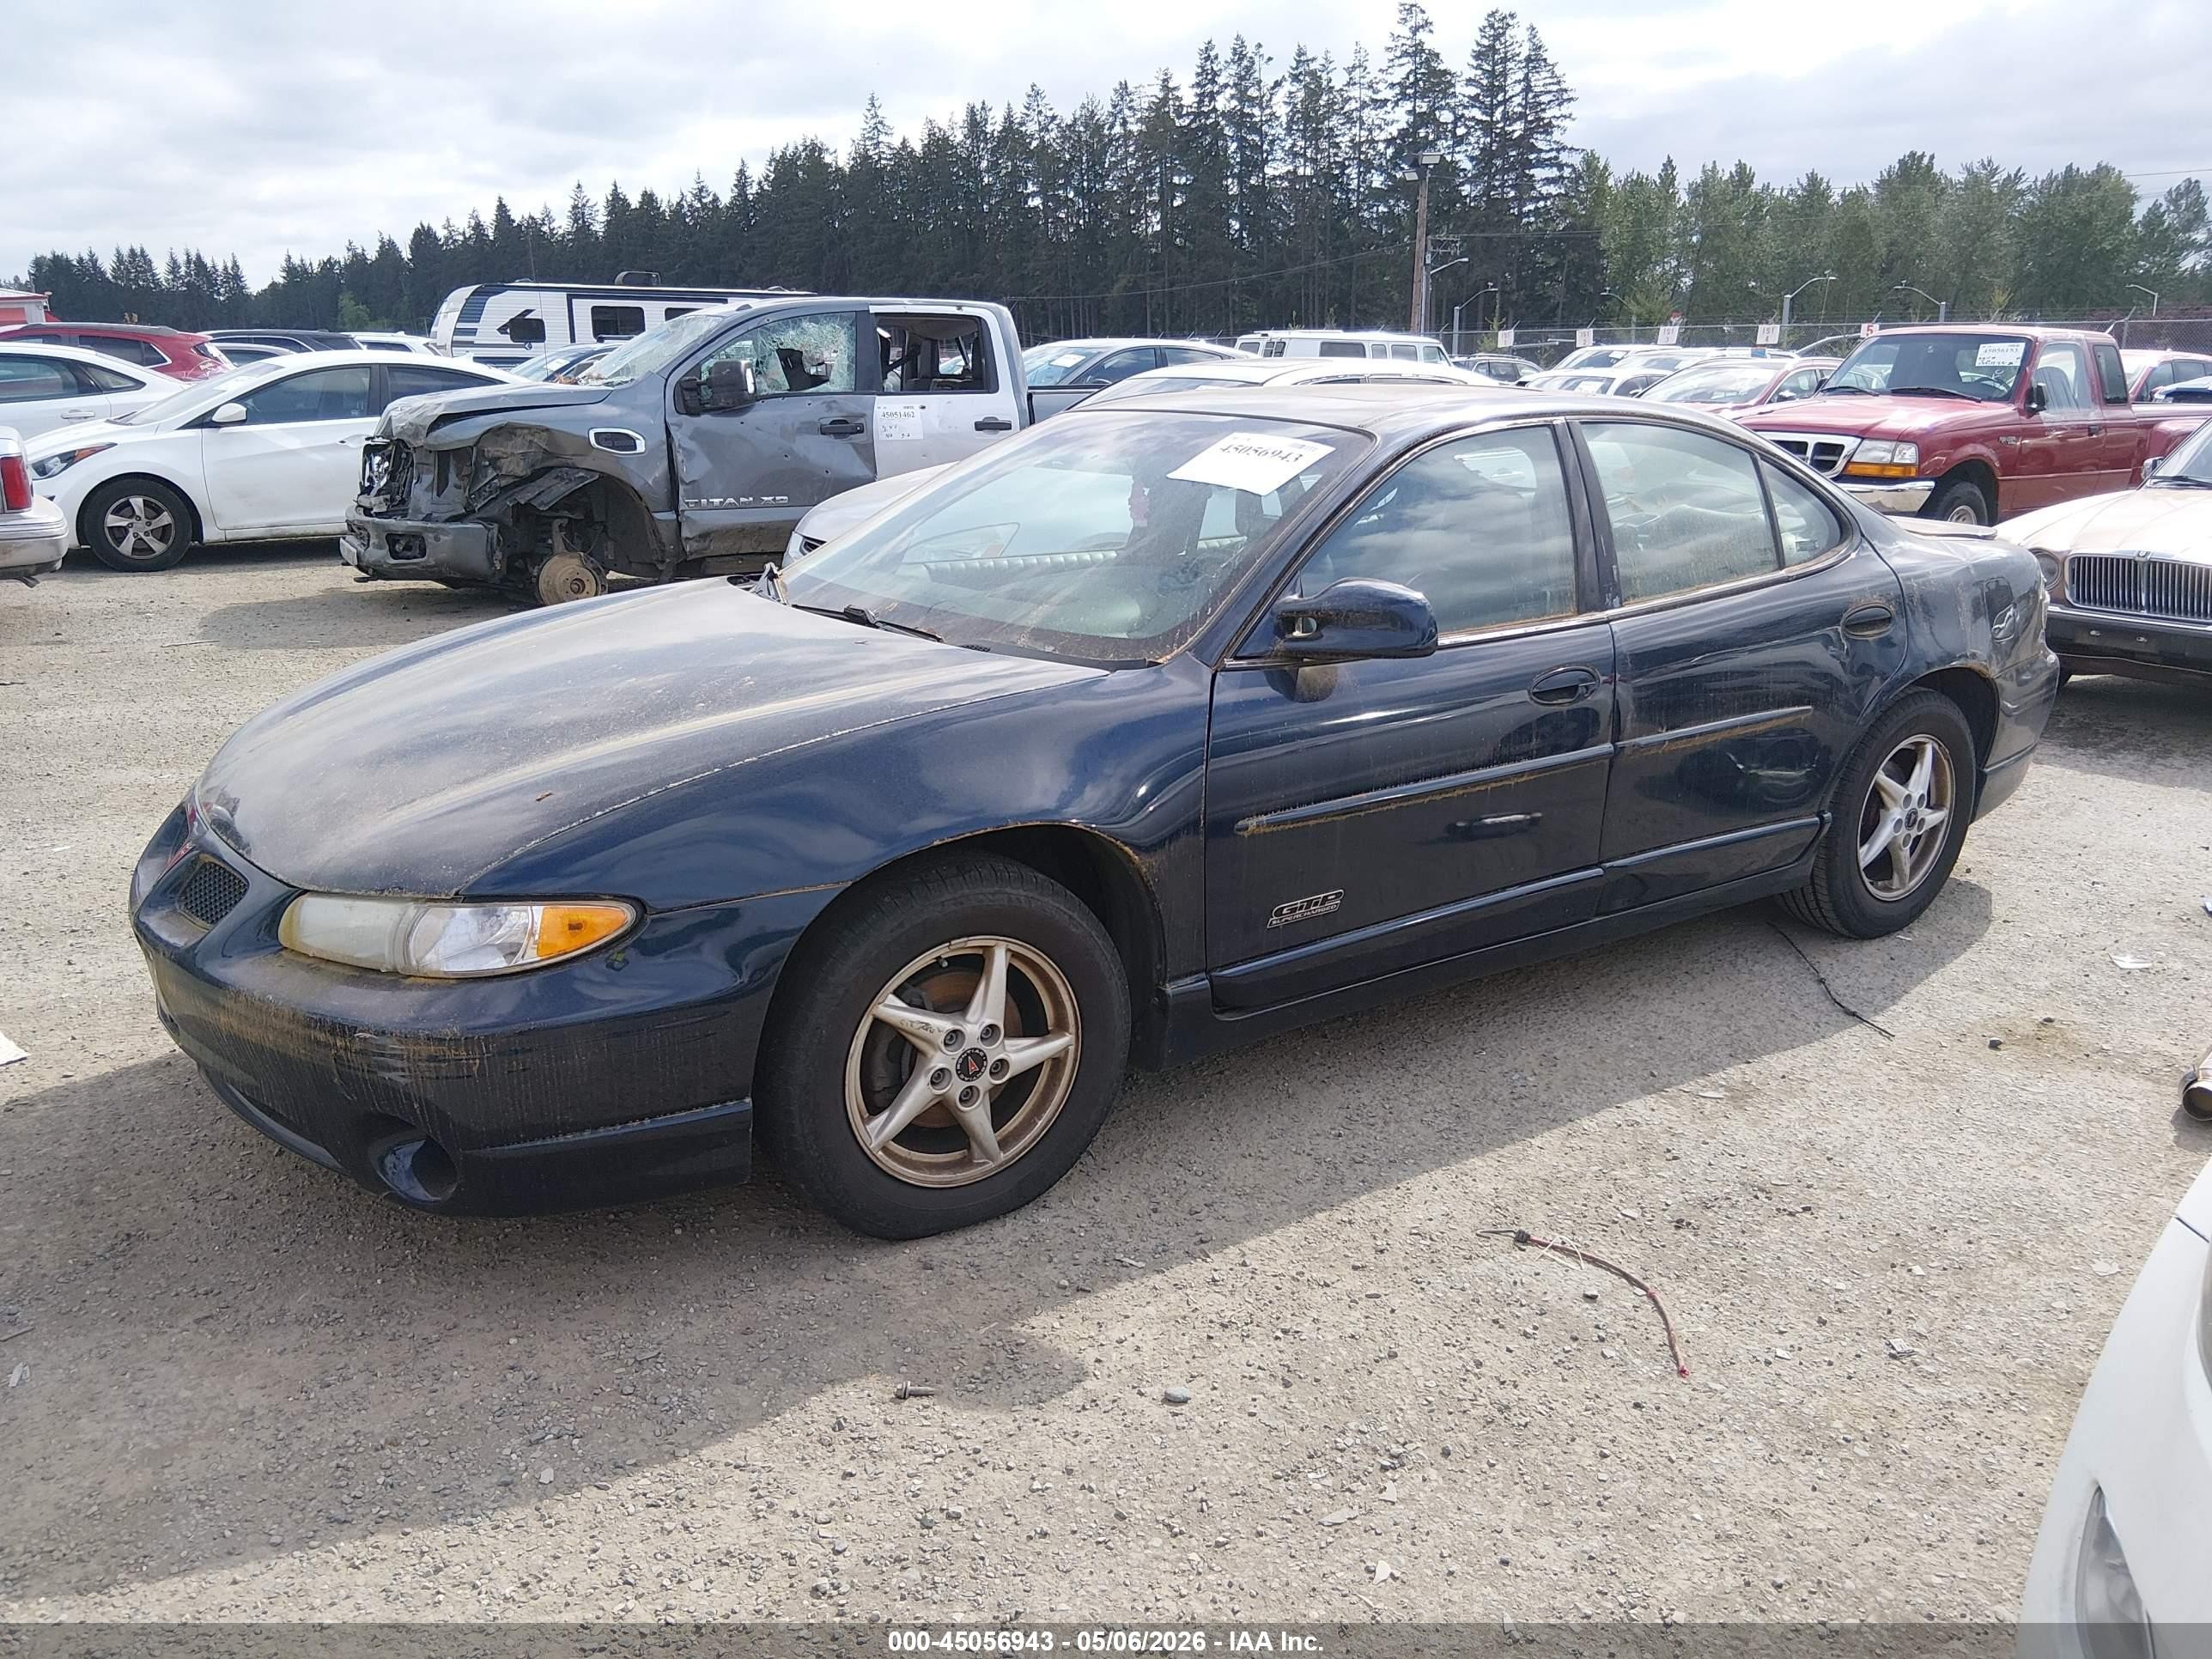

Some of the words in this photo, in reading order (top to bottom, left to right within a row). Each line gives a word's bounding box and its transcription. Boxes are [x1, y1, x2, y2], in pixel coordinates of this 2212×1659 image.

[1219, 444, 1304, 463] 45056943
[684, 497, 753, 507] TITAN
[760, 496, 788, 506] XD
